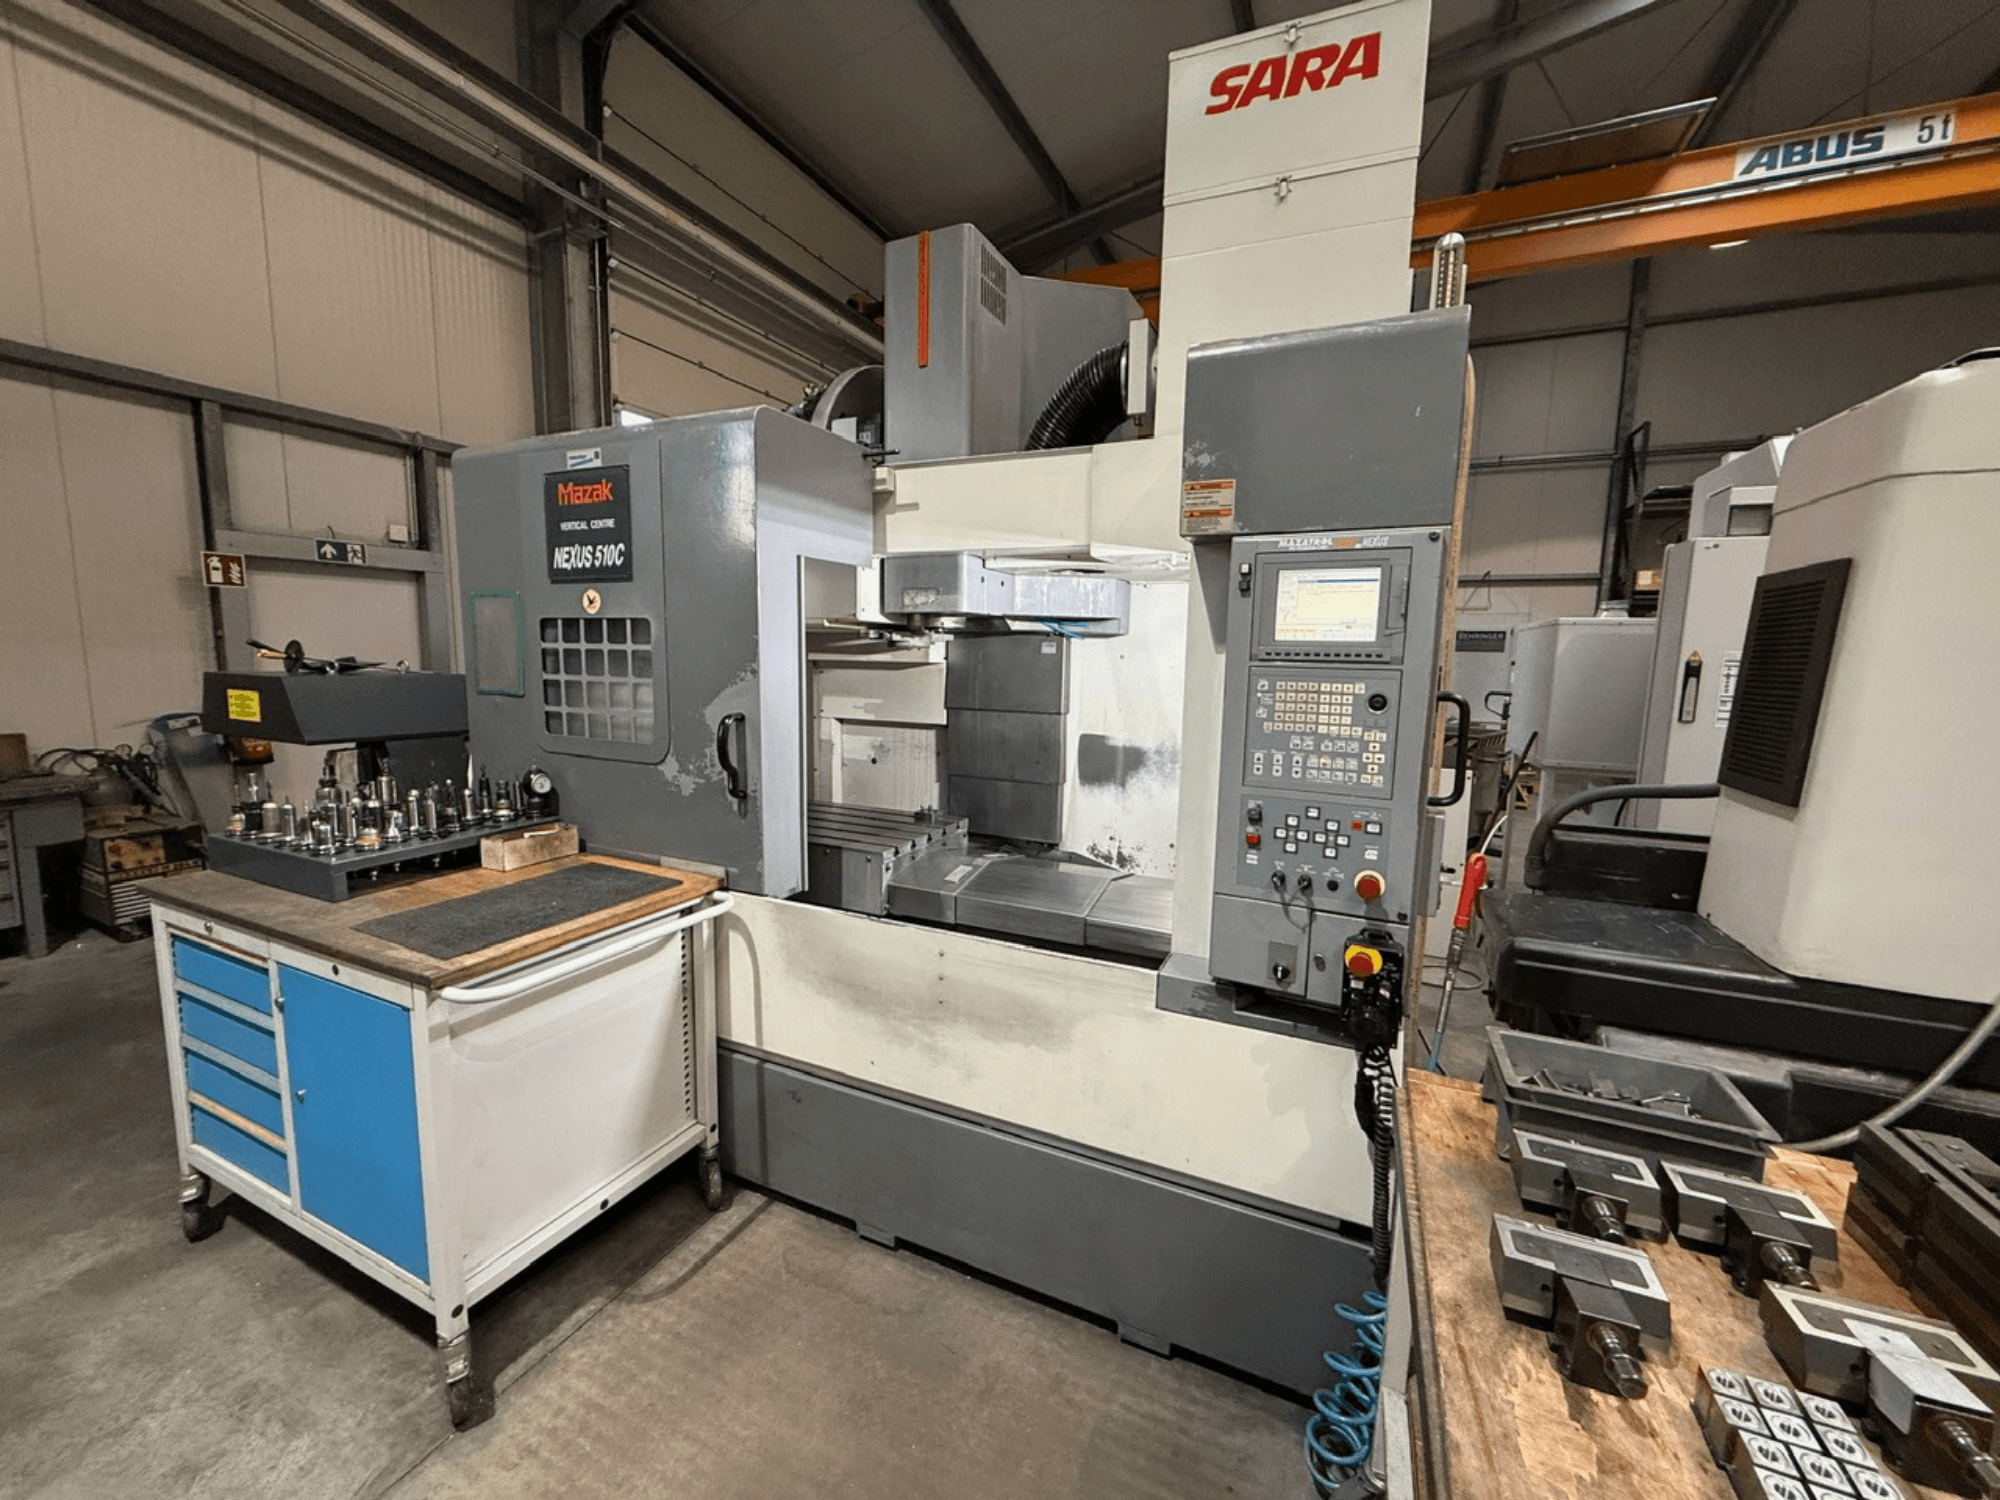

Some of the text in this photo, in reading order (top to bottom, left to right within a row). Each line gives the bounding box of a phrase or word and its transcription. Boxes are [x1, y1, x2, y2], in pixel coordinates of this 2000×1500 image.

[1204, 31, 1382, 116] SARA
[1738, 124, 1887, 177] ABUS
[557, 479, 613, 506] Mazak
[559, 518, 615, 531] VERTICAL CENTRE
[553, 543, 625, 570] NEXUS 510C
